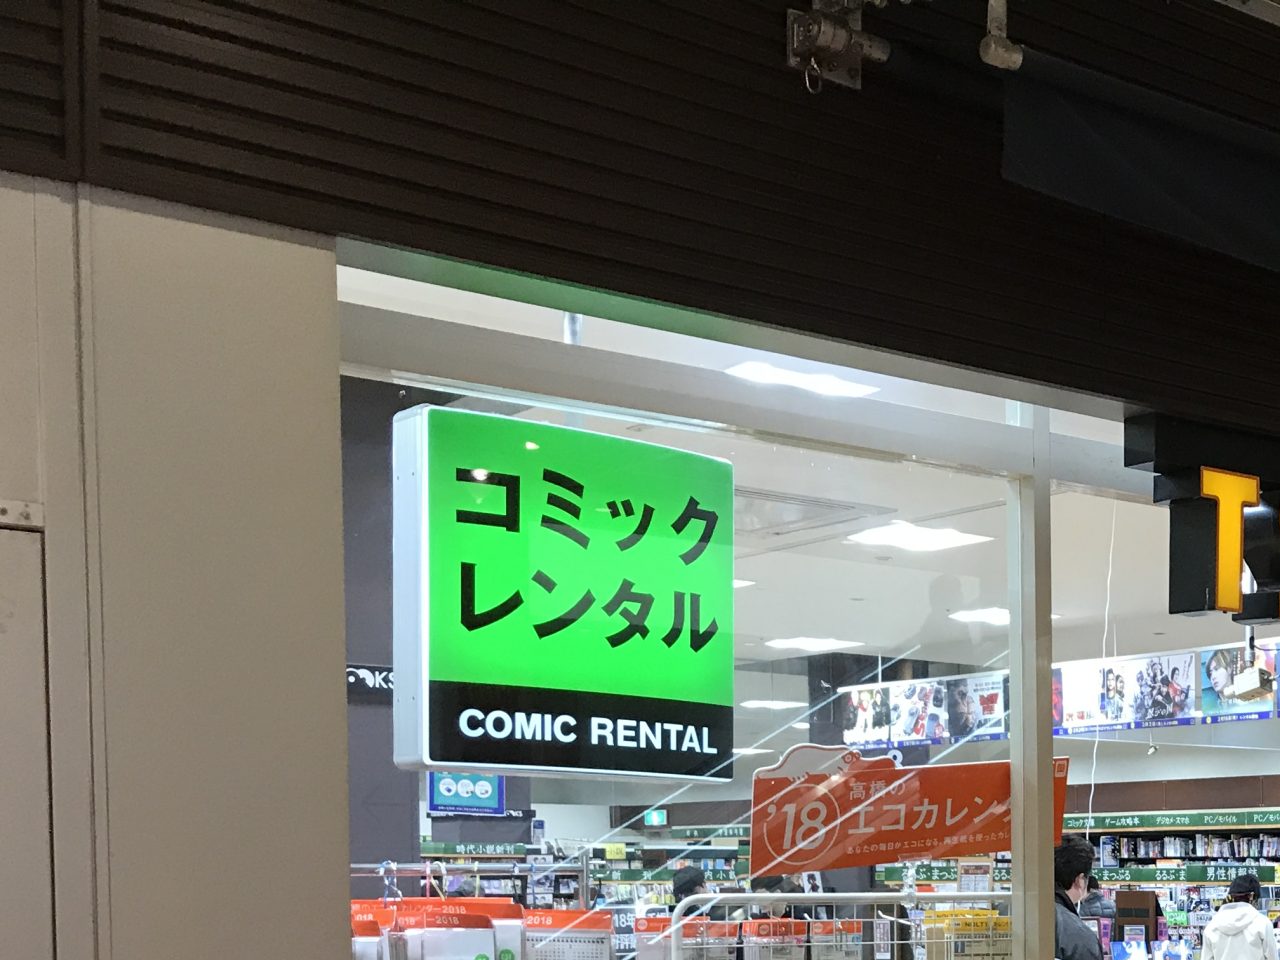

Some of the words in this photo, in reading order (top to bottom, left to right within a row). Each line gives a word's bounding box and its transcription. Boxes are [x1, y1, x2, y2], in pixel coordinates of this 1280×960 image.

[456, 467, 719, 566] コミック
[460, 561, 719, 653] レンタル
[459, 708, 577, 743] COMIC
[591, 717, 717, 754] RENTAL
[1204, 815, 1238, 824] PC/モバイル
[527, 915, 553, 926] 2018
